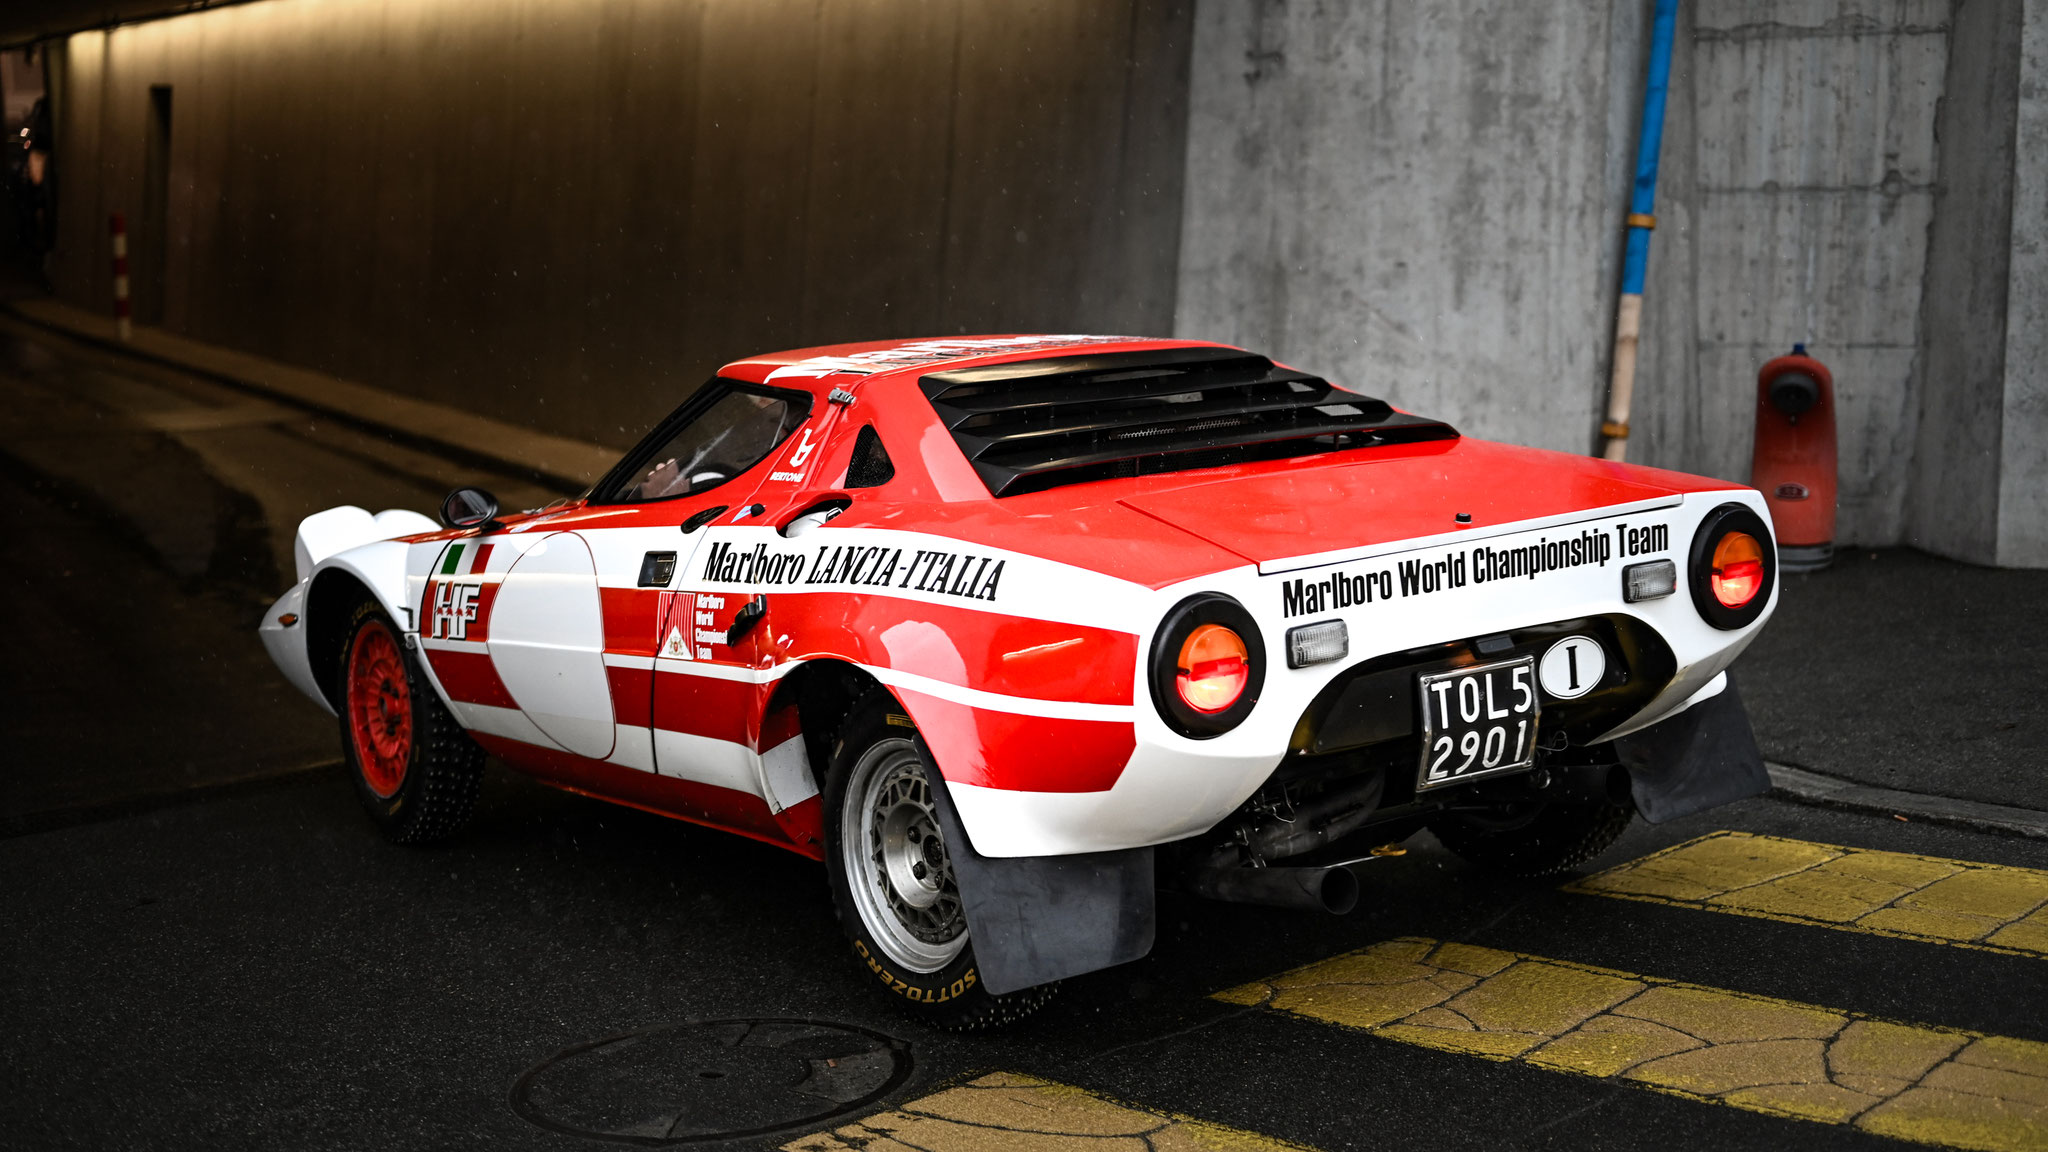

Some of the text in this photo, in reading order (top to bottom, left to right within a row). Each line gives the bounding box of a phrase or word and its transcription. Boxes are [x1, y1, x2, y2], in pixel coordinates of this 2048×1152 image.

[769, 471, 805, 483] BERTONE
[702, 541, 1007, 602] Marlboro LANCIA-ITALIA
[1282, 523, 1669, 618] Marlboro World Championship Team
[431, 581, 482, 641] HF
[695, 610, 714, 626] World
[695, 644, 713, 661] Team
[1565, 645, 1581, 690] I
[1428, 719, 1527, 780] 2901
[853, 938, 977, 1004] SOTTOZERO
